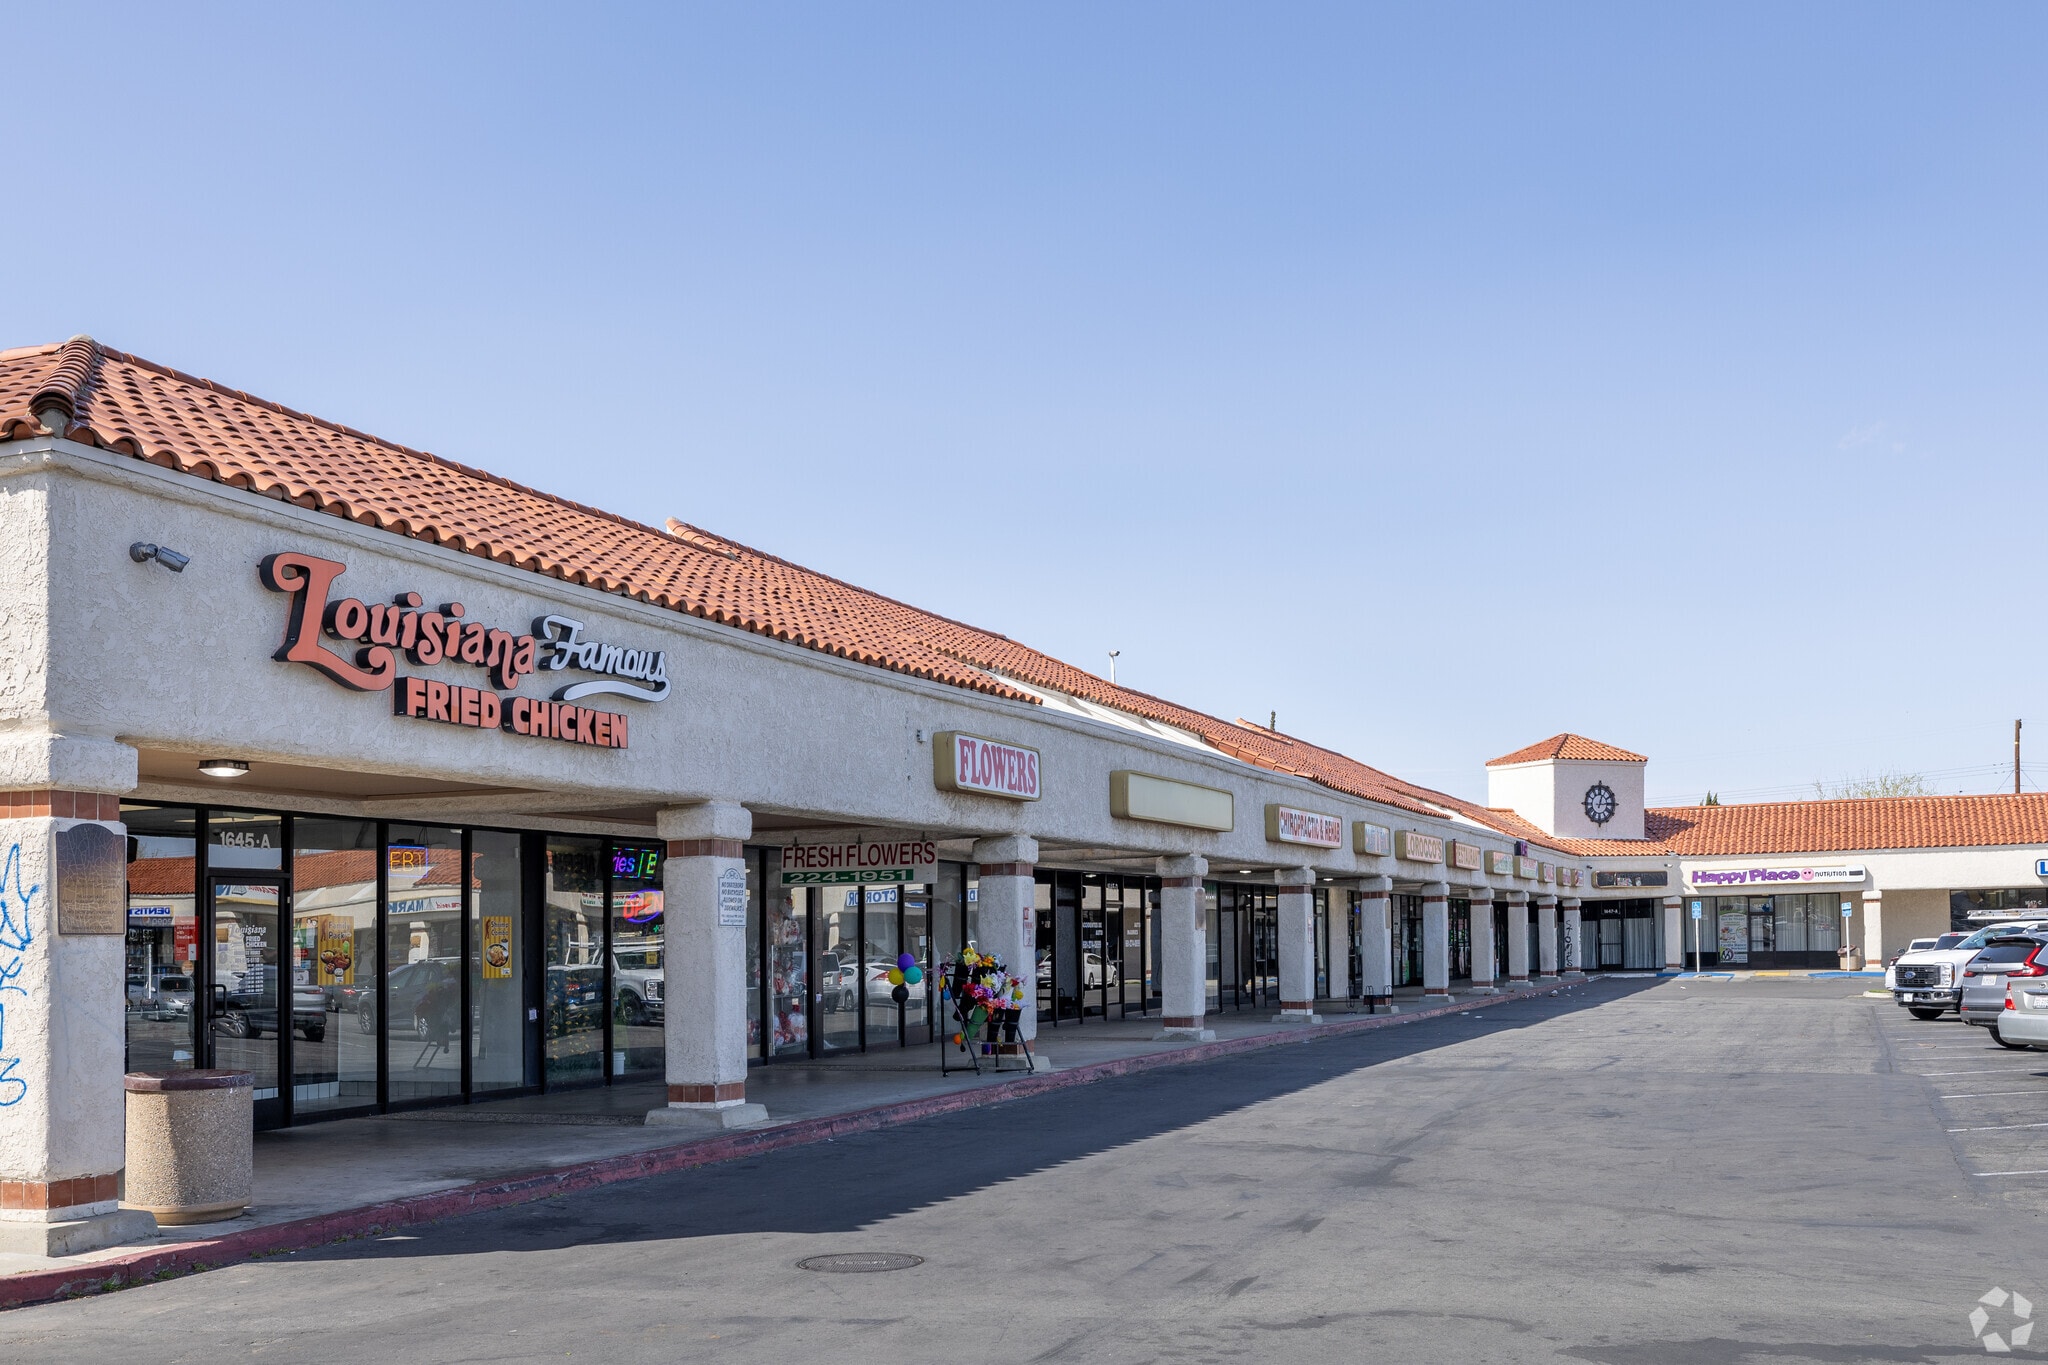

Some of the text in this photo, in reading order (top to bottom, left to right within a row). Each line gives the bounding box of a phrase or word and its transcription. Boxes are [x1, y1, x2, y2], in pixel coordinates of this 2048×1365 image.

[264, 552, 671, 702] Louisiana Famous
[397, 676, 629, 749] FRIED CHICKEN
[958, 738, 1037, 795] FLOWERS
[389, 851, 424, 872] EBT
[782, 841, 936, 869] FRESH FLOWERS
[789, 869, 908, 884] 224-1951
[1691, 870, 1747, 885] Happy
[1749, 868, 1801, 882] Place
[623, 893, 664, 919] OPEN
[328, 921, 351, 930] Family
[328, 931, 344, 940] Pack
